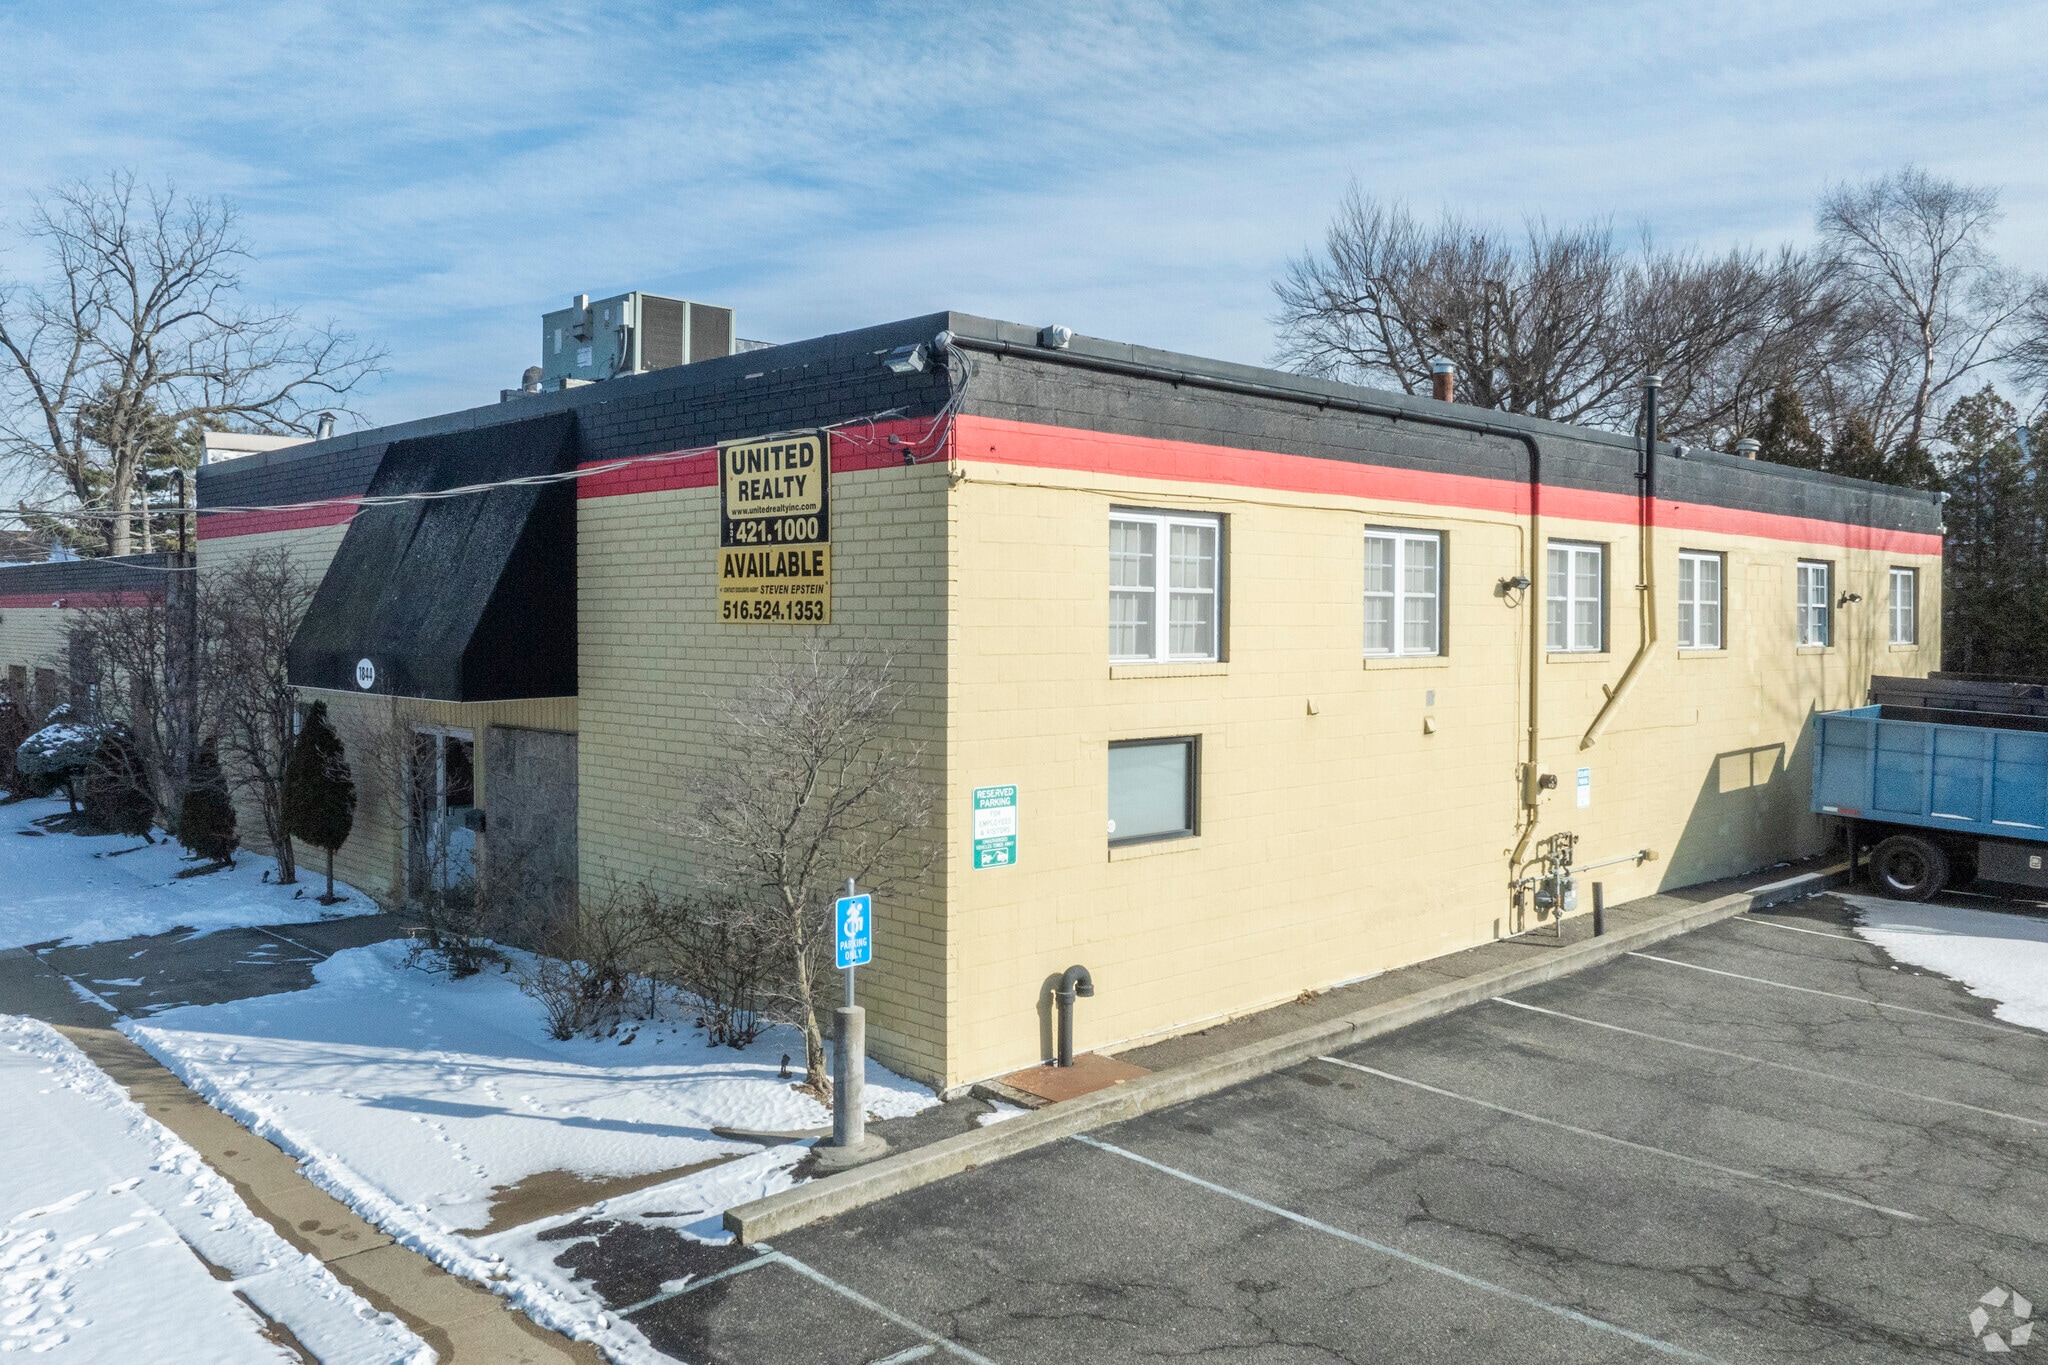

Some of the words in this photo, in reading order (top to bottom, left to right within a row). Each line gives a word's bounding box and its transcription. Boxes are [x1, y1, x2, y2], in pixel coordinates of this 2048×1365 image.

[732, 442, 814, 475] UNITED
[738, 474, 807, 502] REALTY
[732, 503, 817, 516] www.unitedrealtyinc.com
[736, 517, 819, 543] 421.1000
[723, 550, 824, 578] AVAILABLE
[760, 584, 789, 594] STEVEN
[790, 584, 824, 594] EPSTEIN
[723, 600, 824, 621] 516.524.1353
[359, 666, 373, 681] 1844
[977, 788, 1013, 799] RESERVED
[980, 798, 1010, 807] PARKING
[840, 938, 867, 950] PARKING
[845, 949, 862, 960] ONLY
